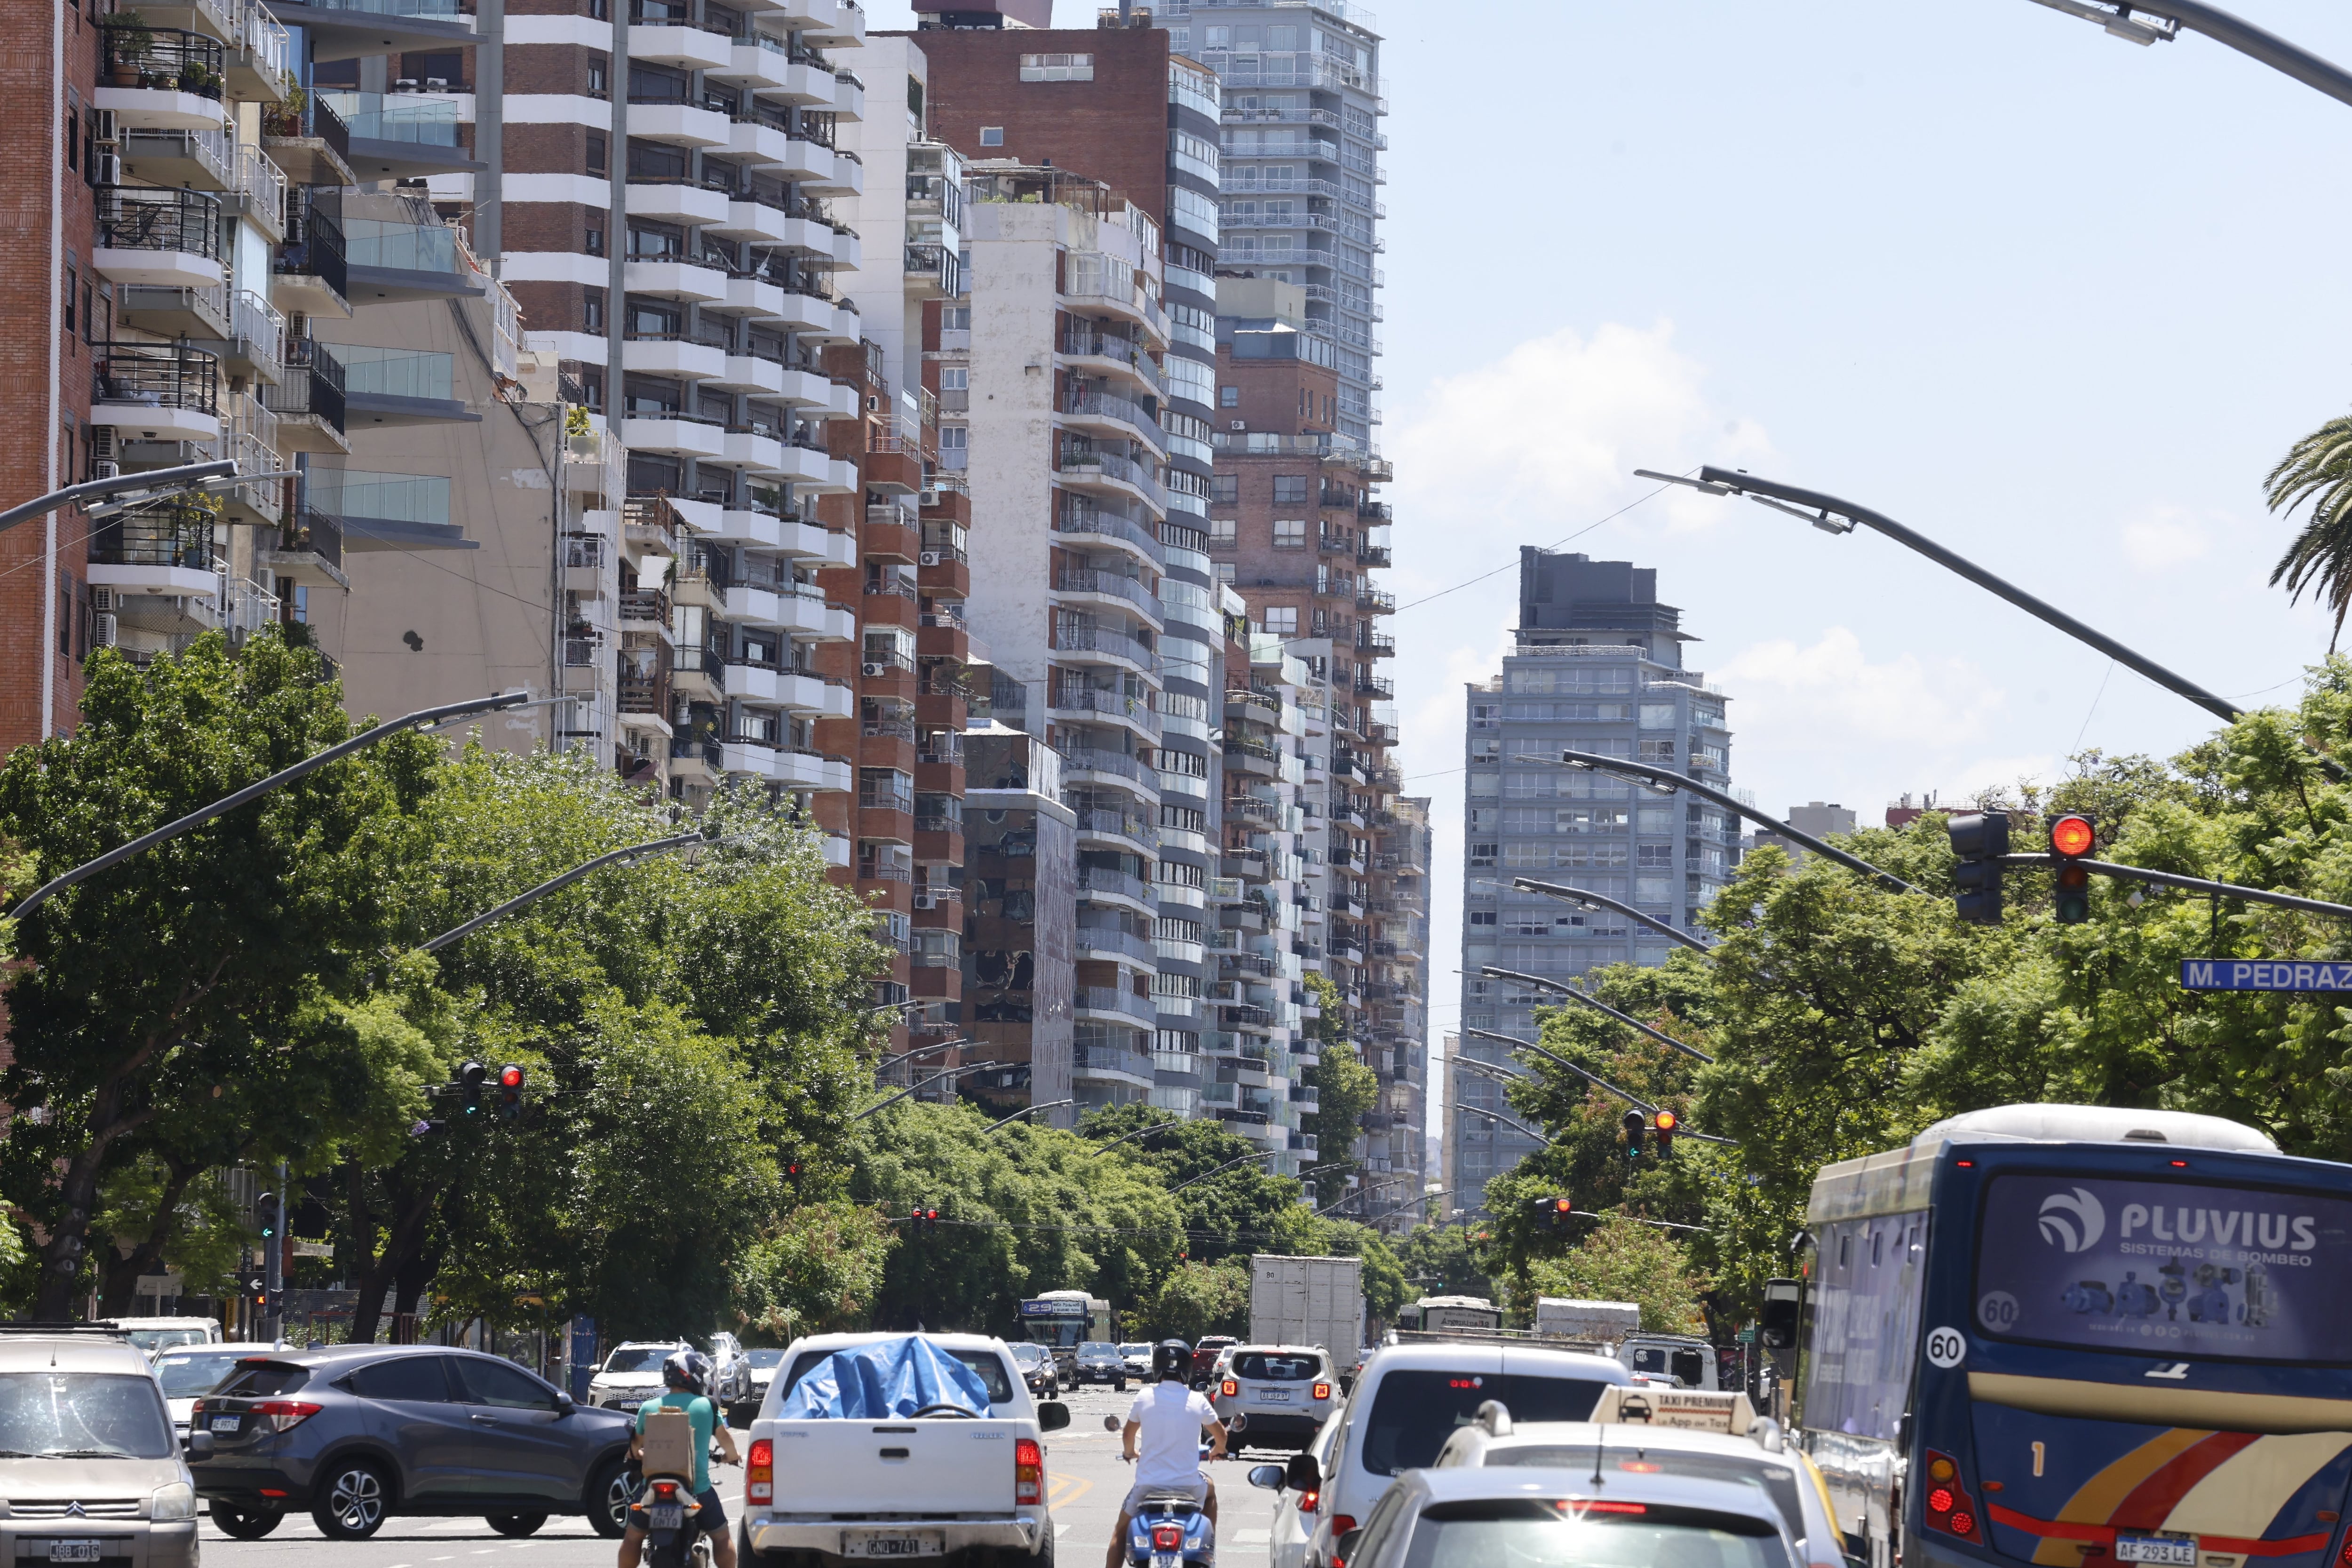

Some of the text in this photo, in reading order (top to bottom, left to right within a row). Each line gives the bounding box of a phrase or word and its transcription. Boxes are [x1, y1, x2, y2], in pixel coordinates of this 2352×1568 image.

[2188, 963, 2221, 986] M.
[2121, 1203, 2316, 1250] PLUVIUS
[2120, 1242, 2312, 1266] SISTEMAS DE BOMBEO
[1984, 1299, 2014, 1324] 60
[1931, 1334, 1959, 1360] 60
[1659, 1395, 1734, 1409] TAXI PREMIUM
[1670, 1417, 1692, 1428] App
[2032, 1441, 2045, 1477] 1
[78, 1545, 98, 1558] 016
[898, 1541, 916, 1553] 741
[2120, 1544, 2192, 1563] AF 293 LE
